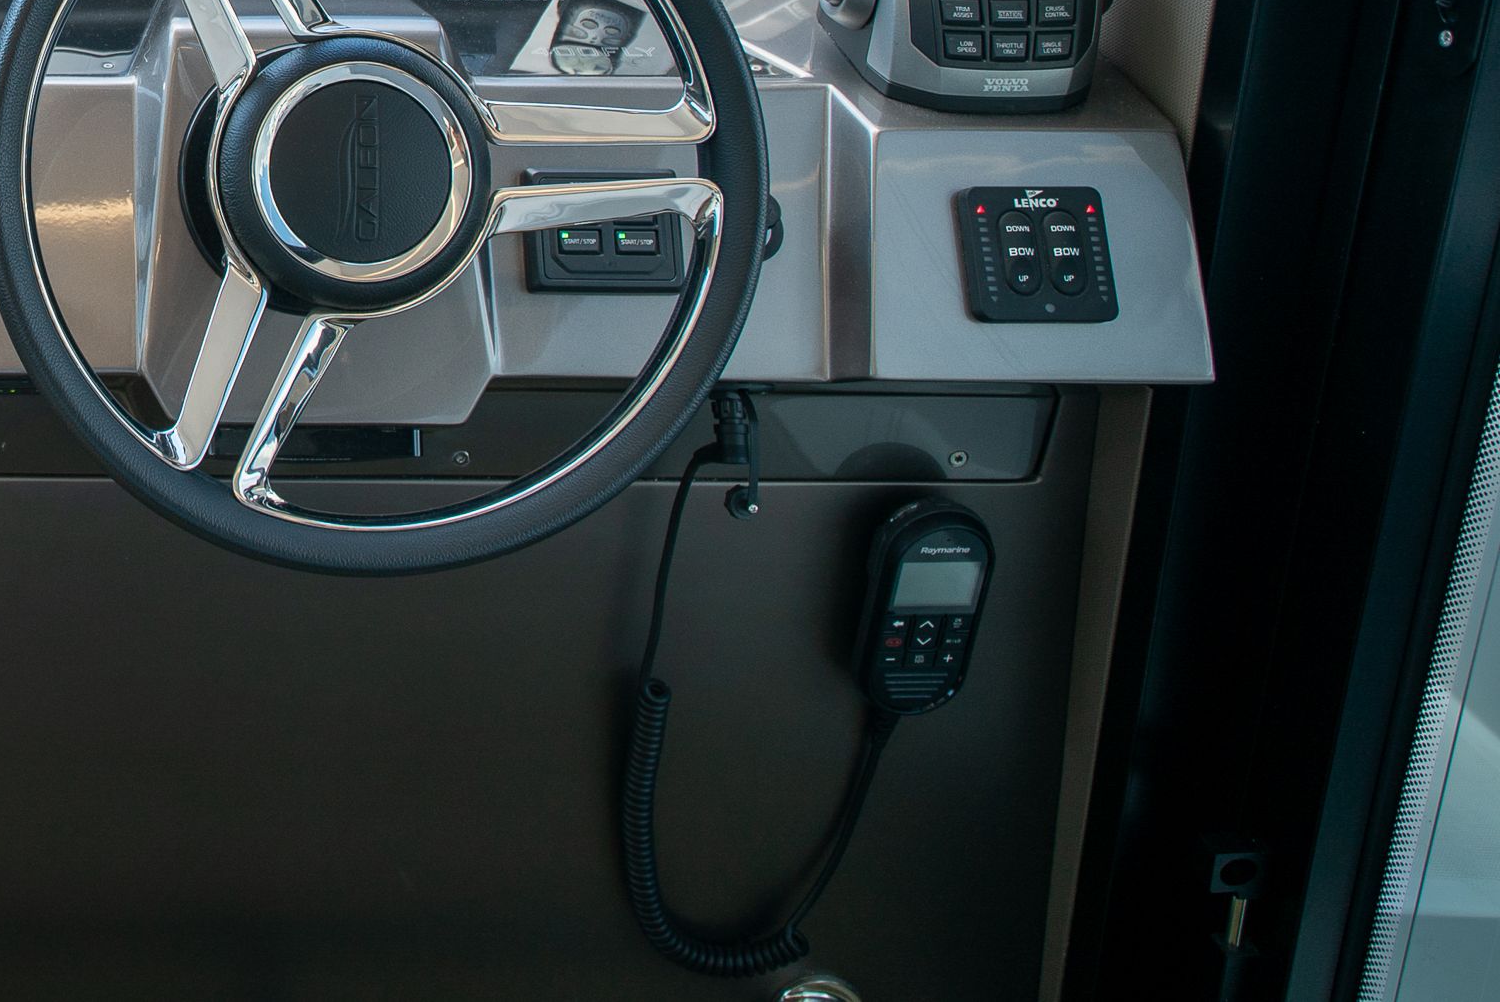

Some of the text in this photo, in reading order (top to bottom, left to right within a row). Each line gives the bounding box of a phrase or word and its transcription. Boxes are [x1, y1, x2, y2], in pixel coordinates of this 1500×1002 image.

[1014, 198, 1057, 208] LENCO
[1008, 248, 1034, 256] BOW
[1054, 248, 1079, 256] BOW
